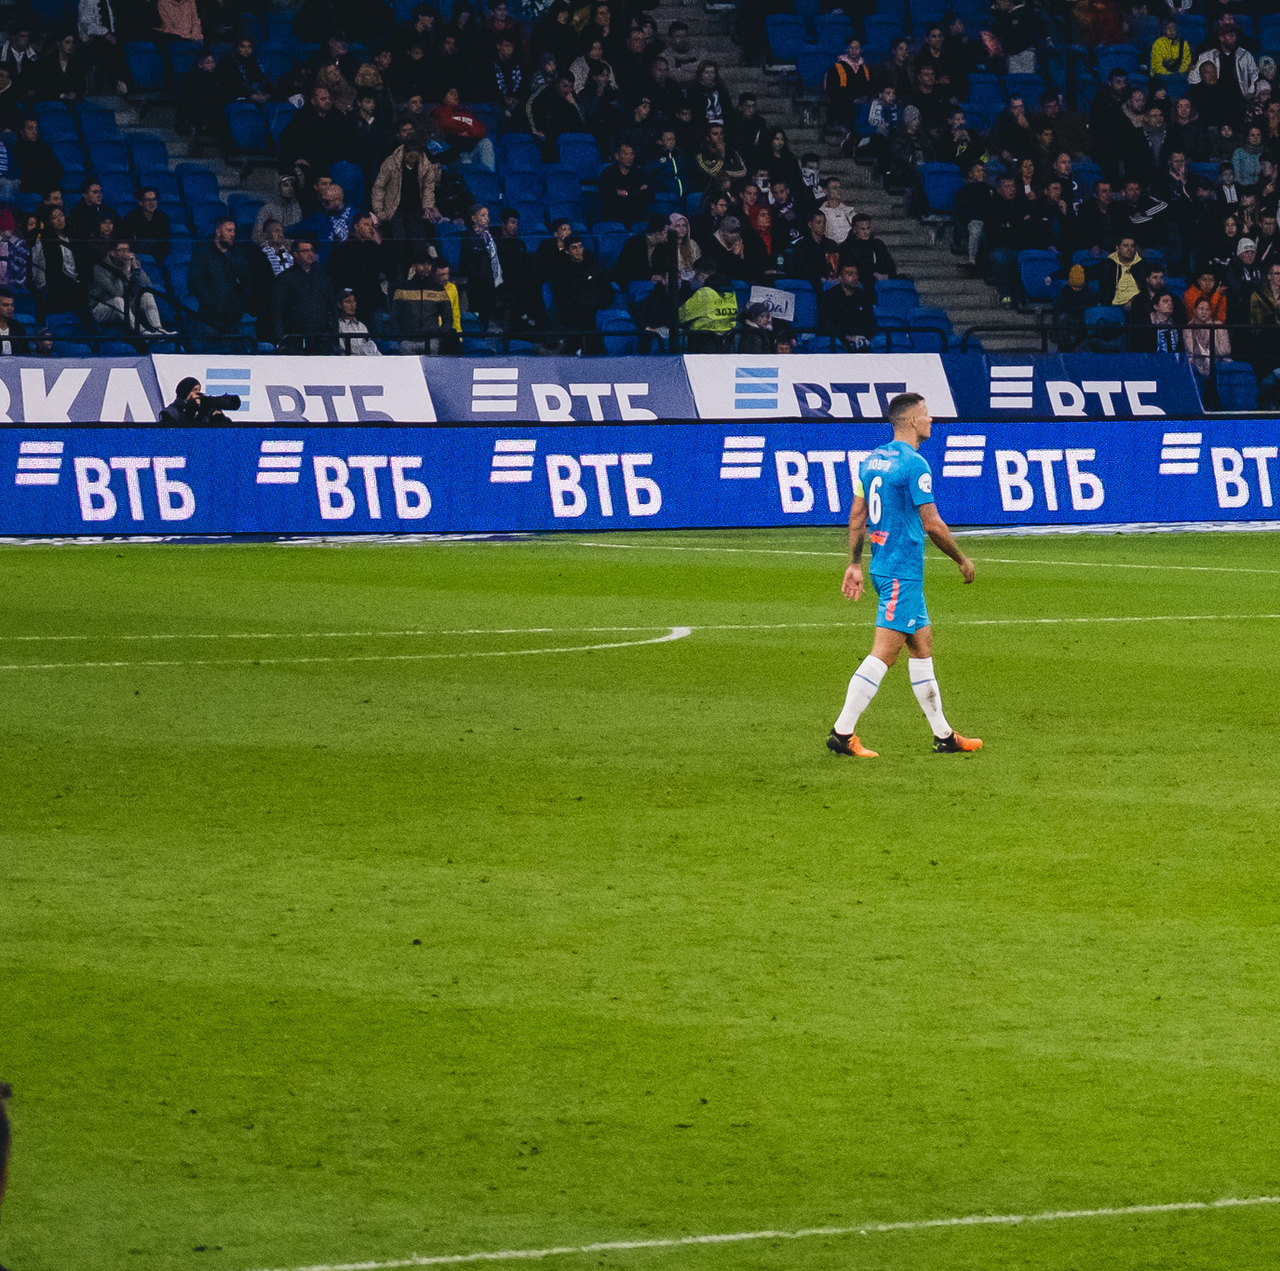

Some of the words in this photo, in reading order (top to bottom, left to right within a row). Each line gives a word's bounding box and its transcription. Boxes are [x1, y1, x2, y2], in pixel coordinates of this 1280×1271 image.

[74, 456, 196, 521] ВТБ
[313, 456, 432, 520] ВТБ
[547, 454, 662, 517] ВТБ
[868, 476, 882, 524] 6
[995, 448, 1106, 511] ВТБ
